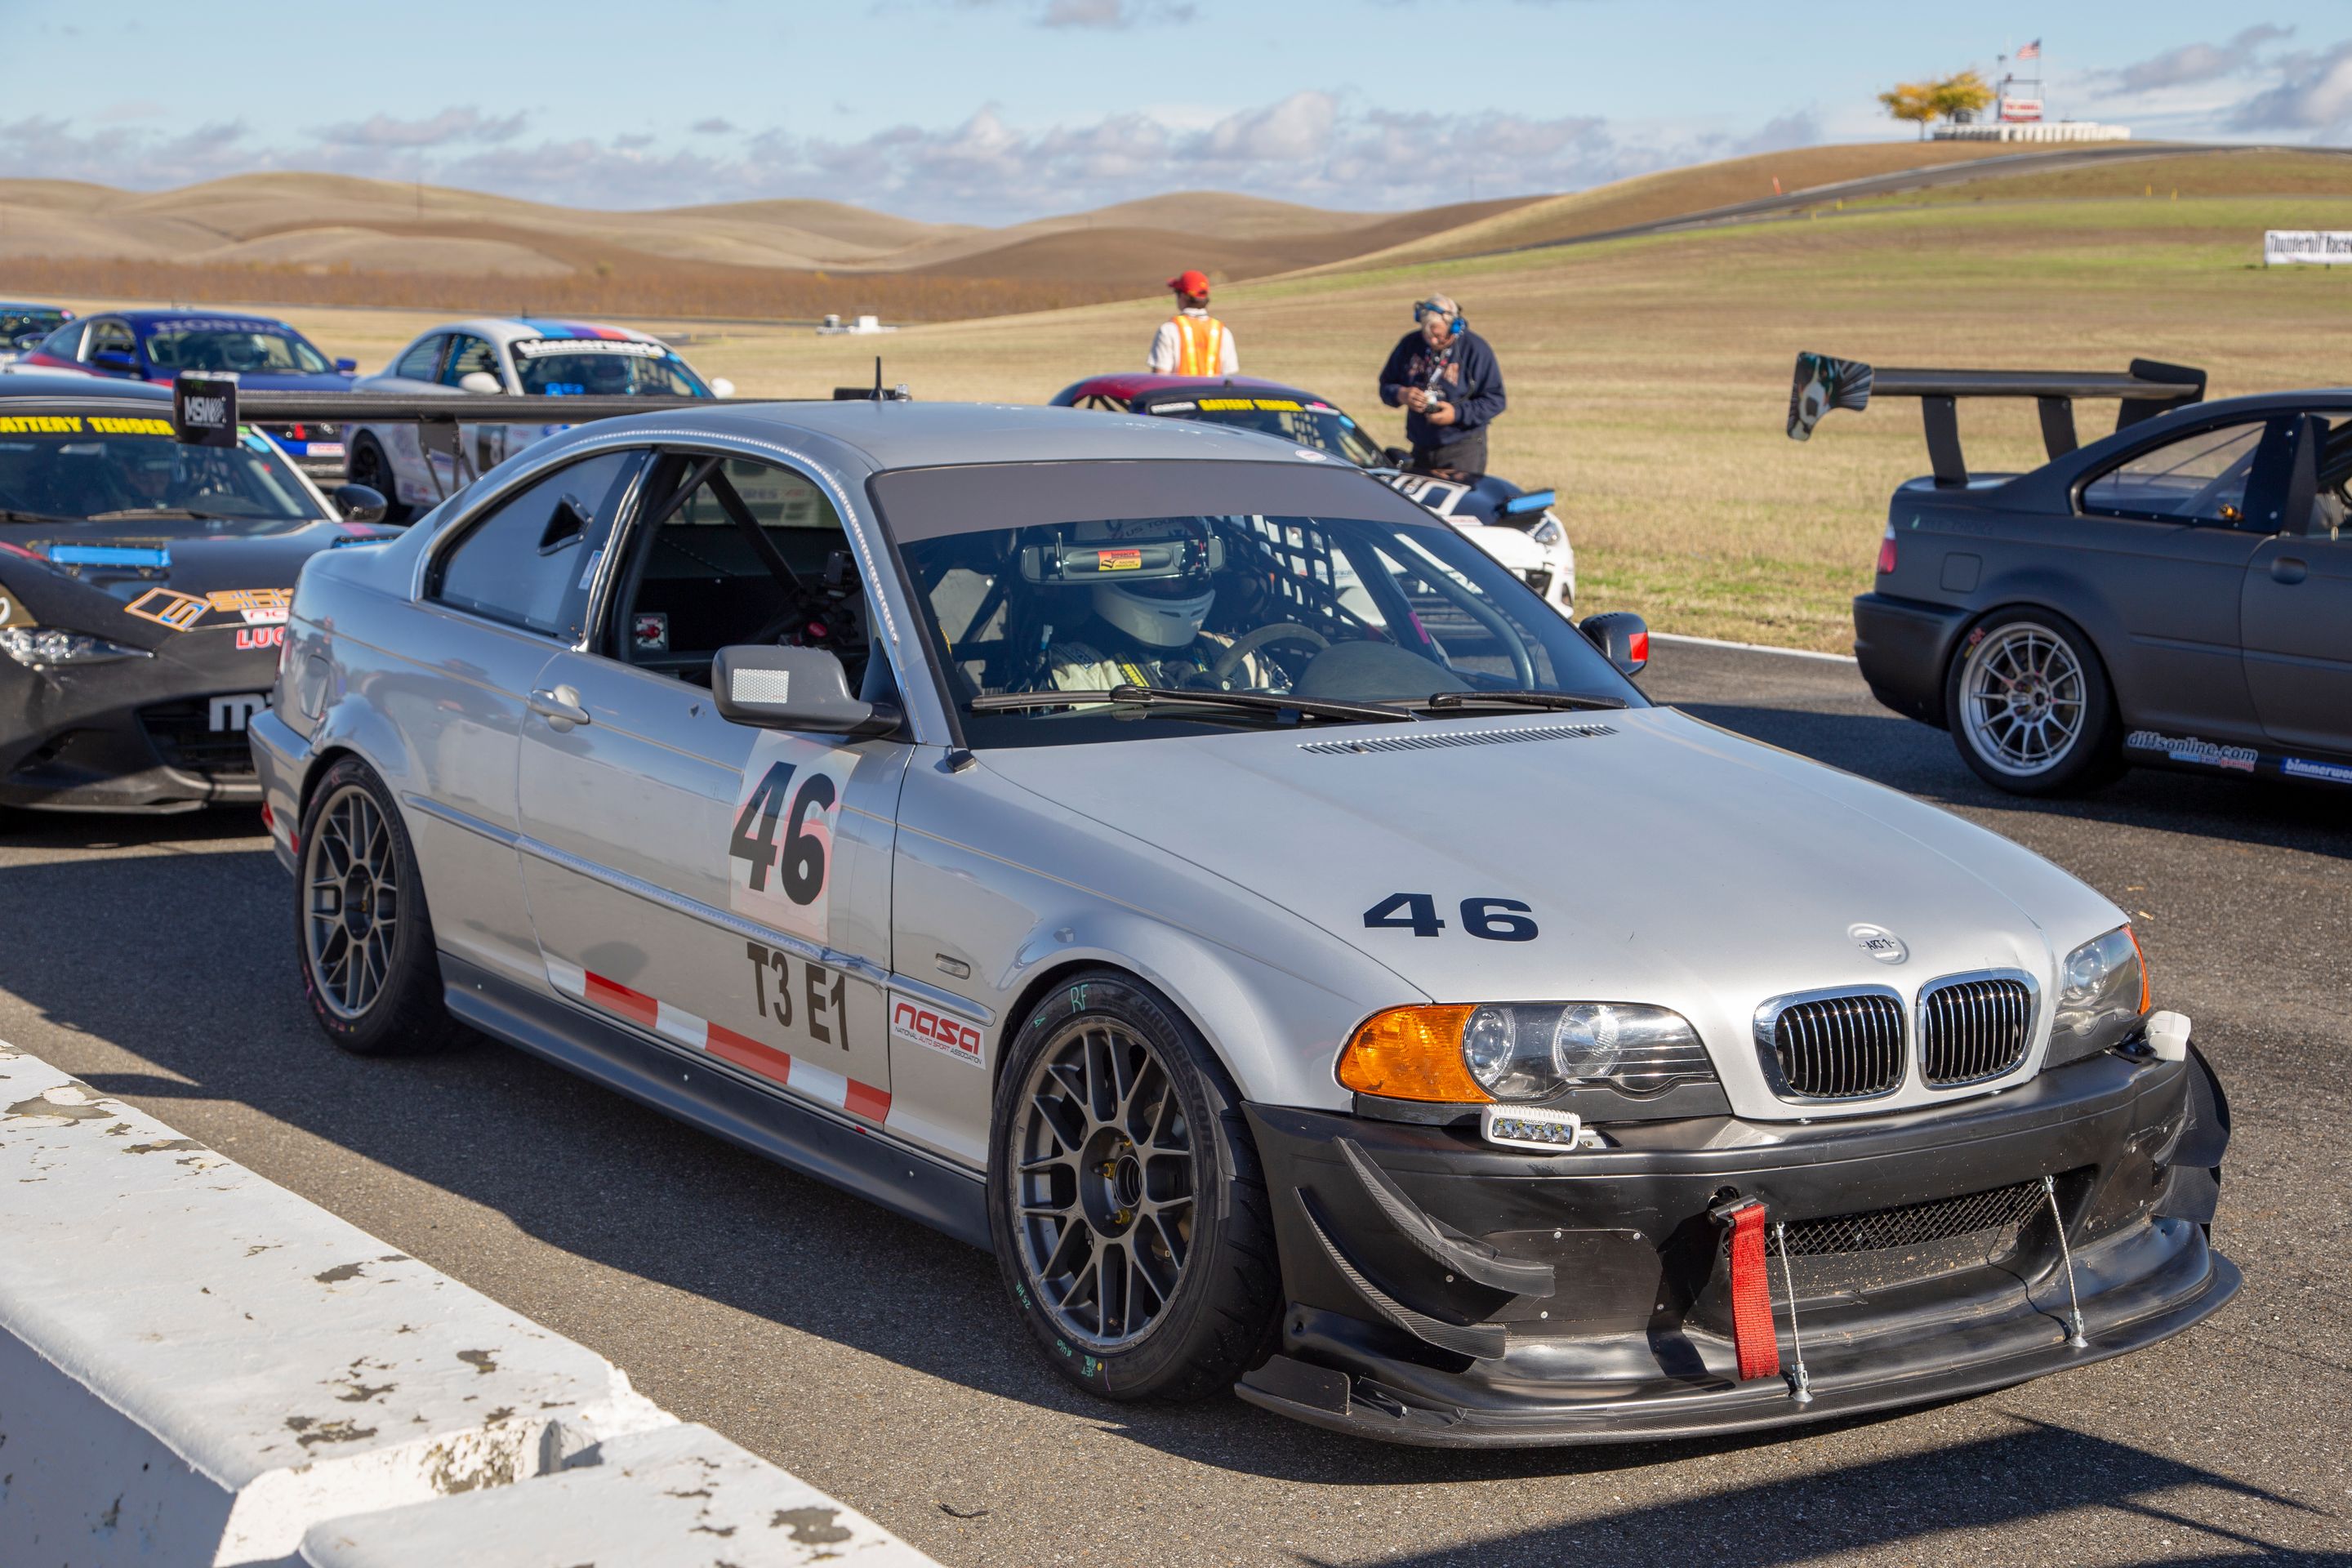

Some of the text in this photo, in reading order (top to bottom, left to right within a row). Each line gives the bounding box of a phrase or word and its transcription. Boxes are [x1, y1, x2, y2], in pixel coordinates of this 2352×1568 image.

[2270, 234, 2352, 253] Thunderhill Race
[87, 416, 176, 435] TENDER
[2127, 731, 2259, 763] diffsonline.com
[728, 761, 835, 906] 46
[1363, 893, 1539, 942] 46
[746, 942, 849, 1052] T3 E1
[1070, 982, 1089, 1013] RF
[894, 1002, 980, 1056] nasa
[894, 1026, 982, 1065] NATIONAL AUTO SPORT ASSOCIATION
